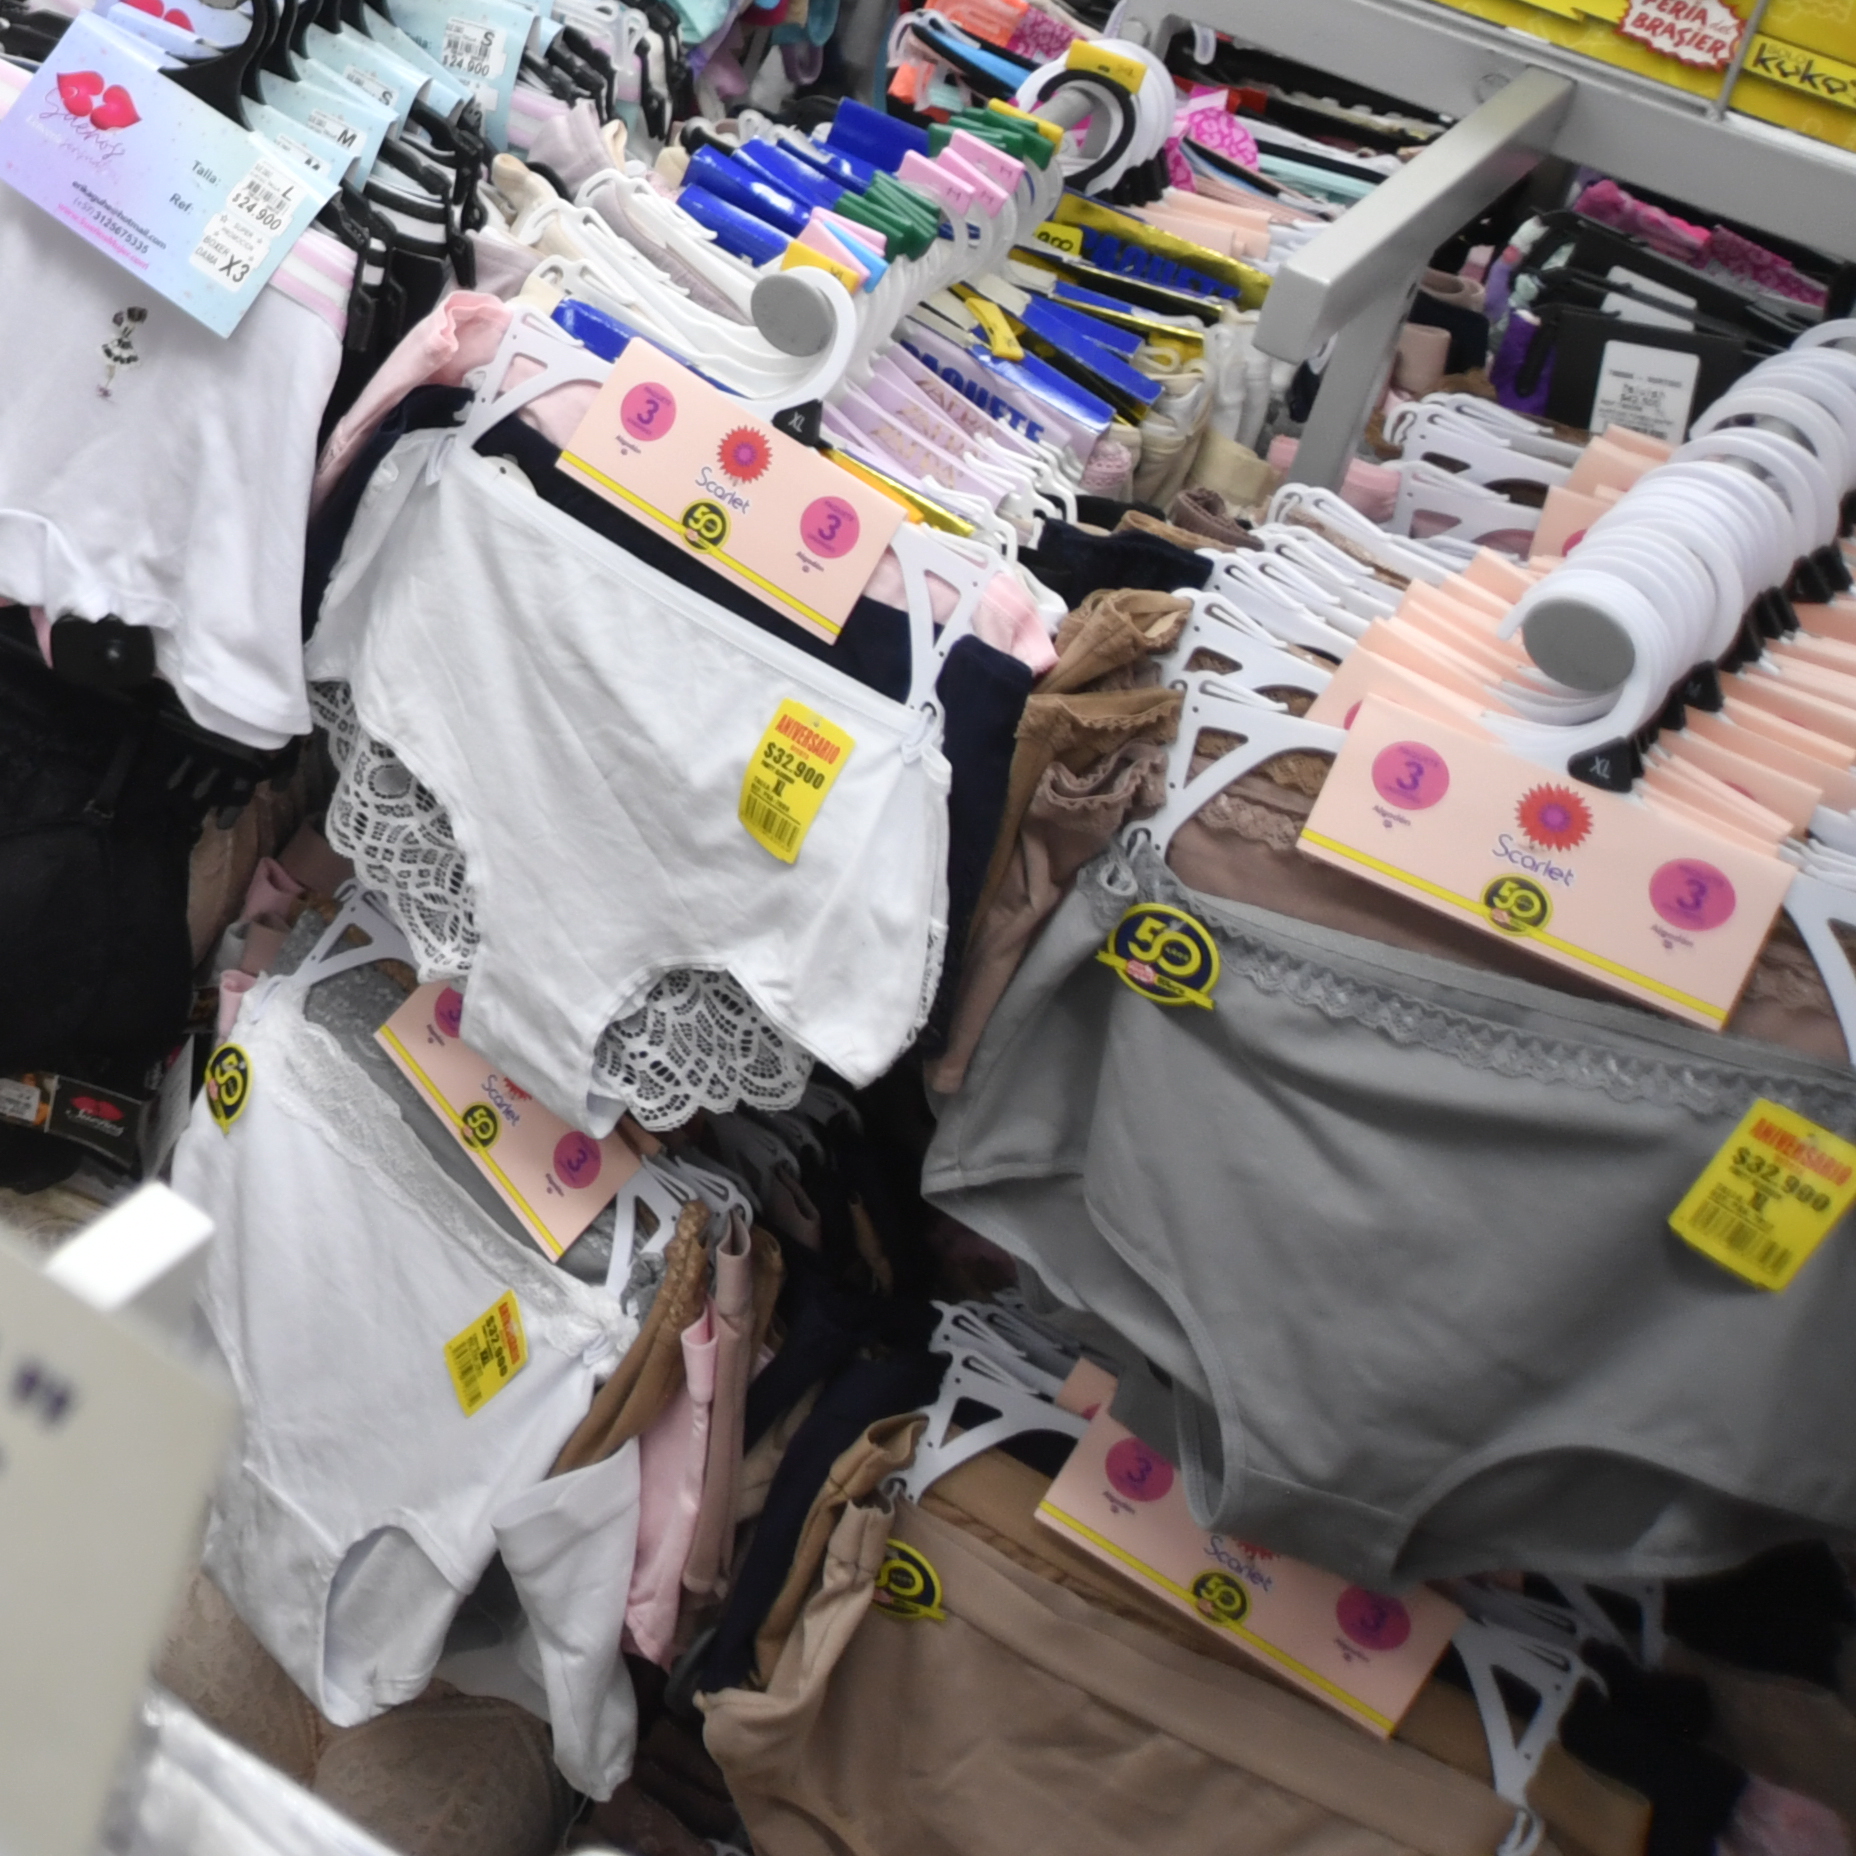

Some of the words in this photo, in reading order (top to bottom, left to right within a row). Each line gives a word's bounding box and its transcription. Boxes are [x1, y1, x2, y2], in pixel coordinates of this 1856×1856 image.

[483, 30, 496, 47] S
[442, 54, 491, 77] $24.900
[378, 89, 394, 106] S
[337, 128, 358, 149] M
[191, 159, 221, 187] Talla:
[169, 192, 194, 213] Ref:
[281, 185, 295, 202] L
[232, 192, 282, 231] $24.900
[194, 245, 219, 266] DAMA
[202, 234, 231, 257] BOXER
[218, 253, 250, 283] X3
[636, 398, 660, 426] 3
[788, 410, 806, 434] XL
[694, 465, 751, 515] Scarlet
[688, 505, 723, 539] 50
[817, 513, 842, 541] 3
[774, 713, 841, 765] ANIVERSARIO
[763, 741, 826, 790] $32.900
[1395, 760, 1425, 792] 3
[1589, 755, 1612, 780] XL
[1491, 832, 1576, 888] Scarlet
[1492, 879, 1542, 919] 50
[1675, 877, 1708, 912] 3
[1127, 915, 1202, 977] 50
[214, 1052, 244, 1106] 50
[480, 1073, 521, 1128] Scarlet
[466, 1107, 495, 1140] 50
[566, 1148, 588, 1173] 3
[1203, 1533, 1275, 1593] Scarlet
[1199, 1575, 1242, 1612] 50
